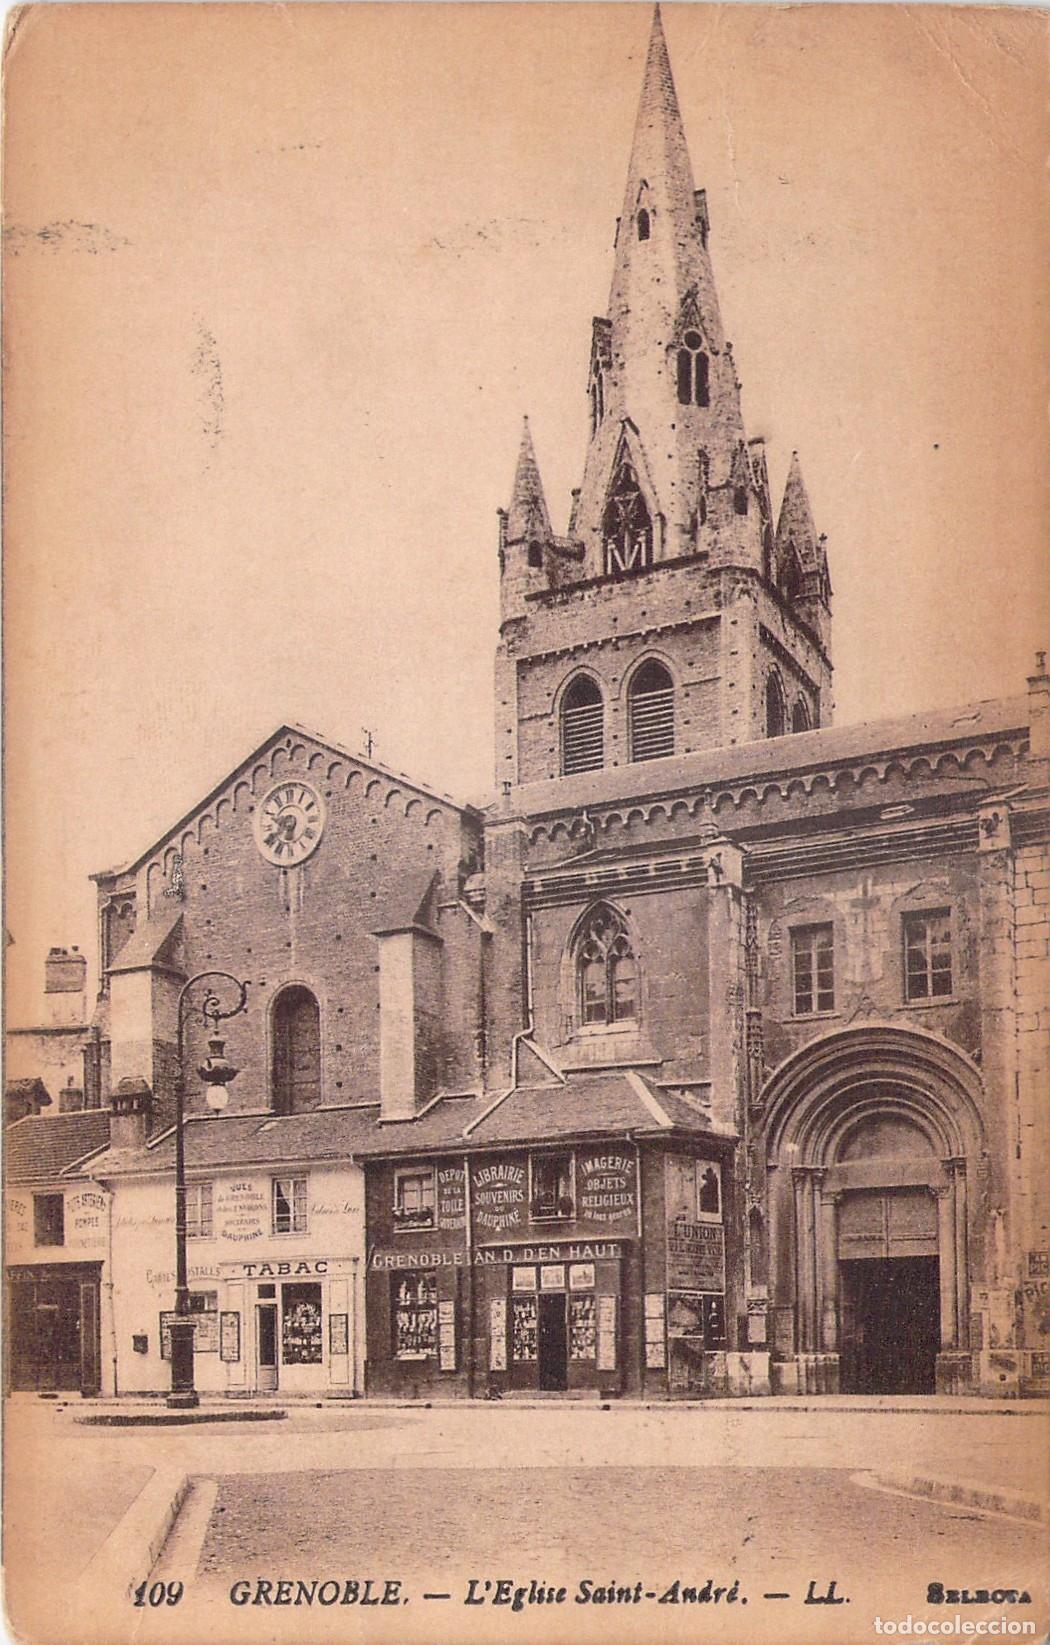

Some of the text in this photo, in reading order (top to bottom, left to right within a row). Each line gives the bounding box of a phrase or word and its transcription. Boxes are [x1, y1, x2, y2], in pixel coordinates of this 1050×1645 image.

[581, 1156, 634, 1176] IMAGERIE
[439, 1168, 466, 1183] DEPOT
[473, 1165, 525, 1187] LIBRAIRIE
[586, 1177, 626, 1191] OBJETS
[475, 1190, 524, 1205] SOUVENIRS
[582, 1193, 634, 1207] RELIGIEUX
[441, 1199, 464, 1213] TOILE
[477, 1208, 521, 1228] DAUPHINÉ
[373, 1253, 463, 1268] GRENOBLE
[524, 1248, 560, 1261] D'EN
[570, 1244, 618, 1258] HAUT
[243, 1261, 328, 1276] TABAC
